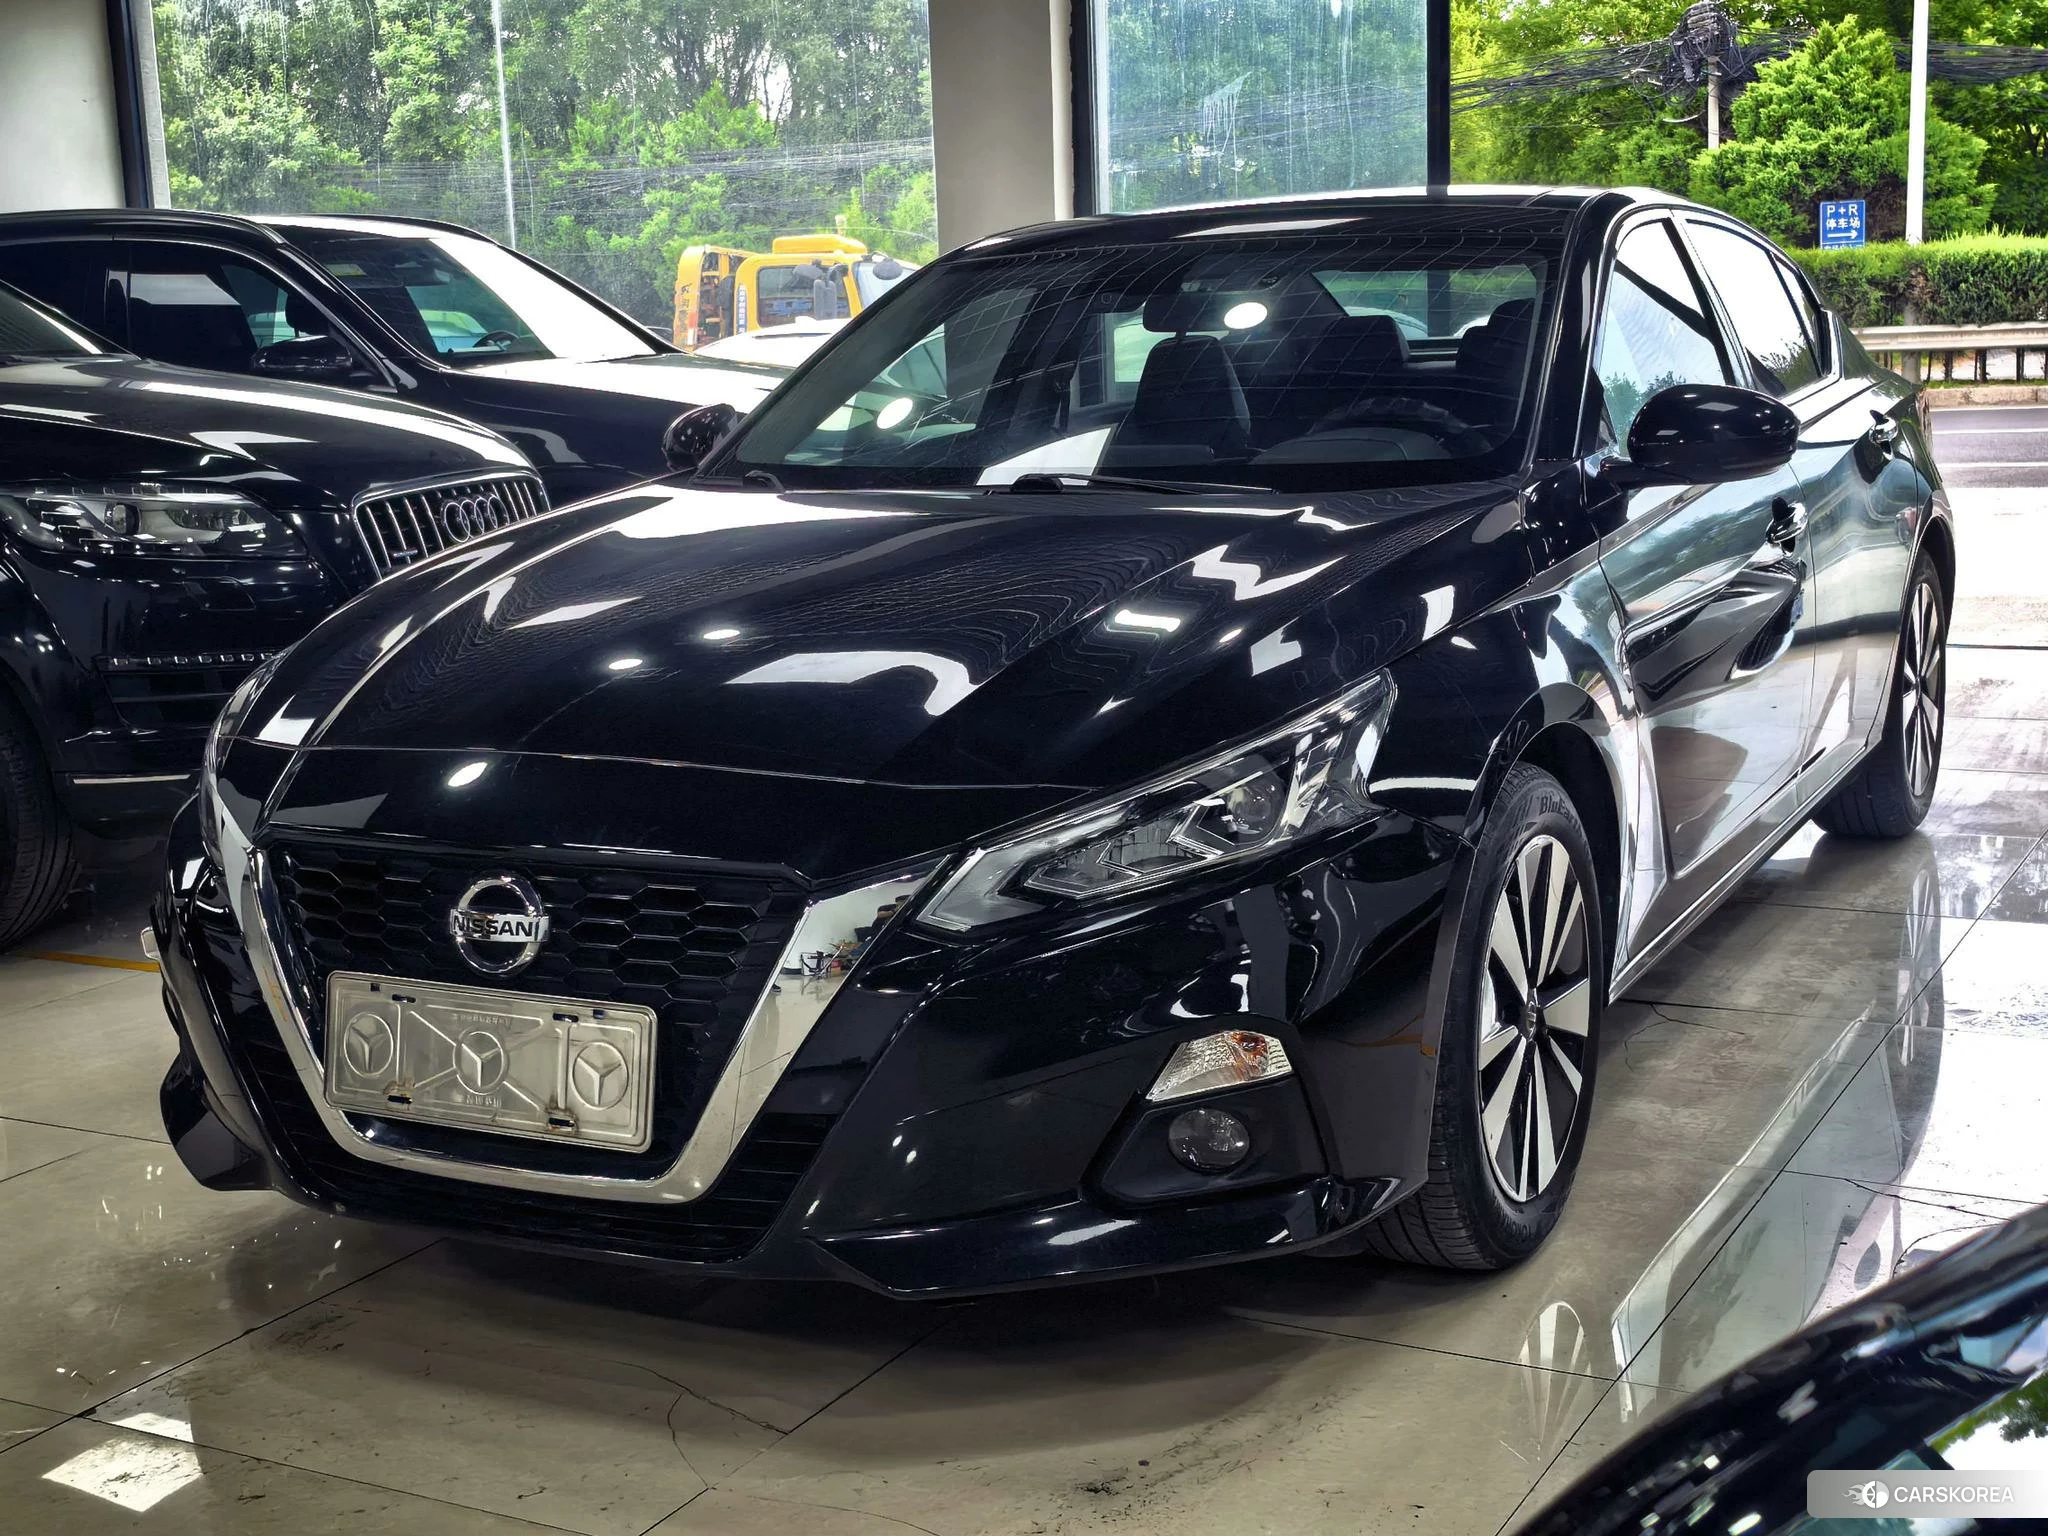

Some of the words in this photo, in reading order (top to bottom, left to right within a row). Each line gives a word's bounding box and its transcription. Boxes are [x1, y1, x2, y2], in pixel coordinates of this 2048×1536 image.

[1826, 216, 1861, 230] 停车场
[453, 914, 533, 937] NISSAN
